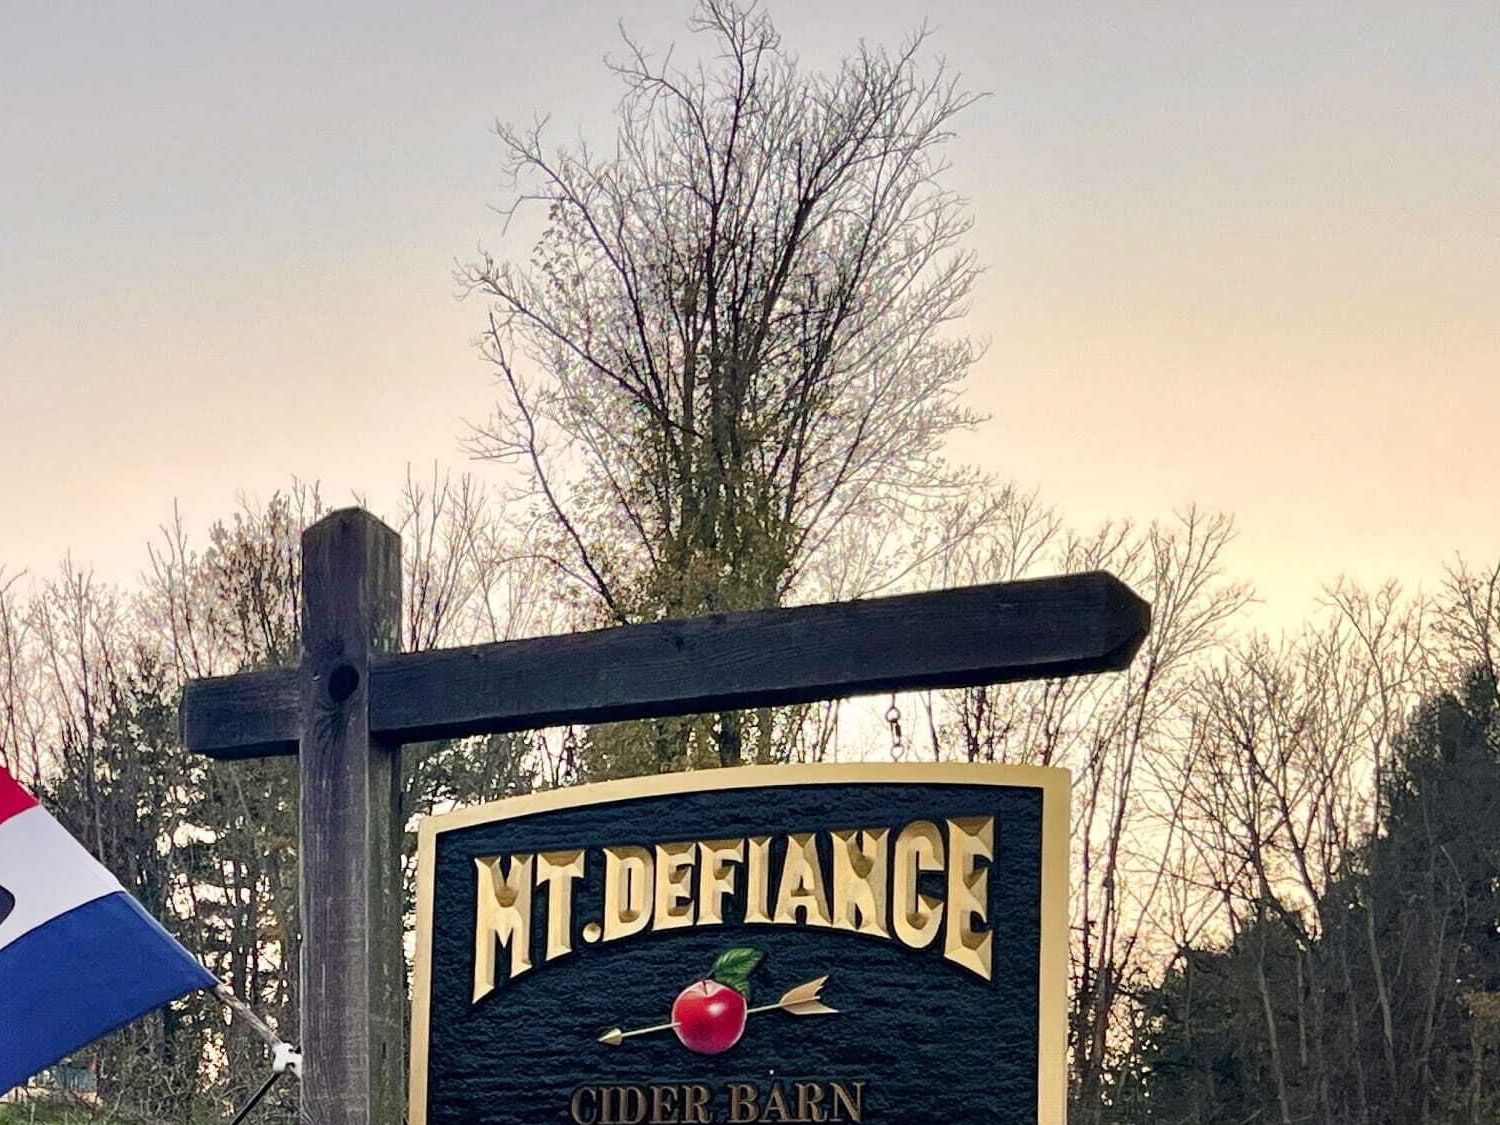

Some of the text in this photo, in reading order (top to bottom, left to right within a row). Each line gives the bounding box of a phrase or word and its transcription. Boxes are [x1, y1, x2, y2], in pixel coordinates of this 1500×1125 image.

[472, 816, 995, 1004] MT. DEFIANCE
[571, 1081, 867, 1125] CIDER BARN
